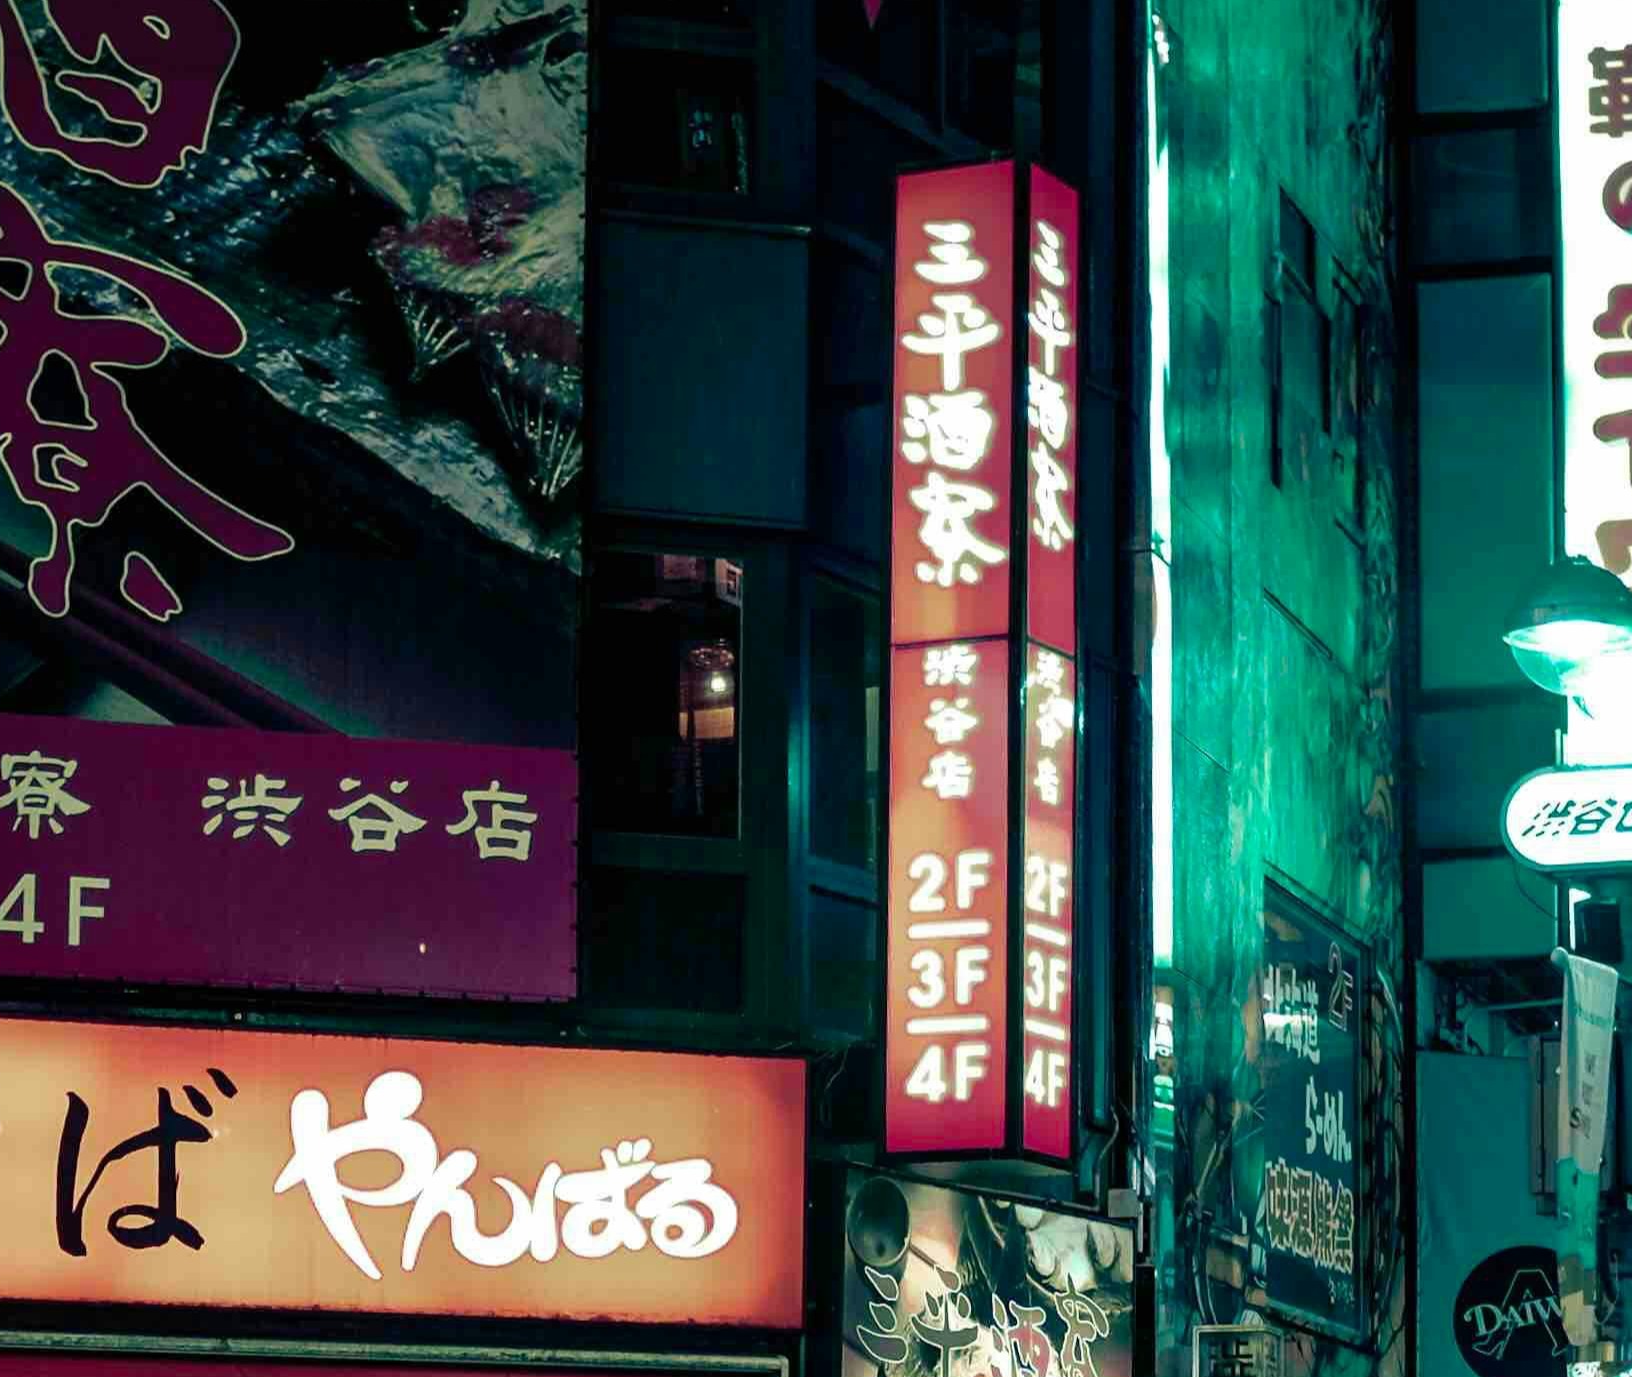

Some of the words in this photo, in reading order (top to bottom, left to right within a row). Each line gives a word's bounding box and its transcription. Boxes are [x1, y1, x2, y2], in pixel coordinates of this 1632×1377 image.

[901, 220, 1009, 588] 三平酒寮
[923, 643, 979, 800] 渋谷店
[201, 773, 538, 862] 渋谷店
[907, 849, 992, 914] 2F
[1025, 854, 1067, 918] 2F
[907, 946, 989, 1008] 3F
[1025, 950, 1067, 1012] 3F
[1329, 942, 1353, 1032] 2F
[905, 1045, 988, 1103] 4F
[1023, 1045, 1067, 1107] 4F
[274, 1070, 740, 1280] やんばる
